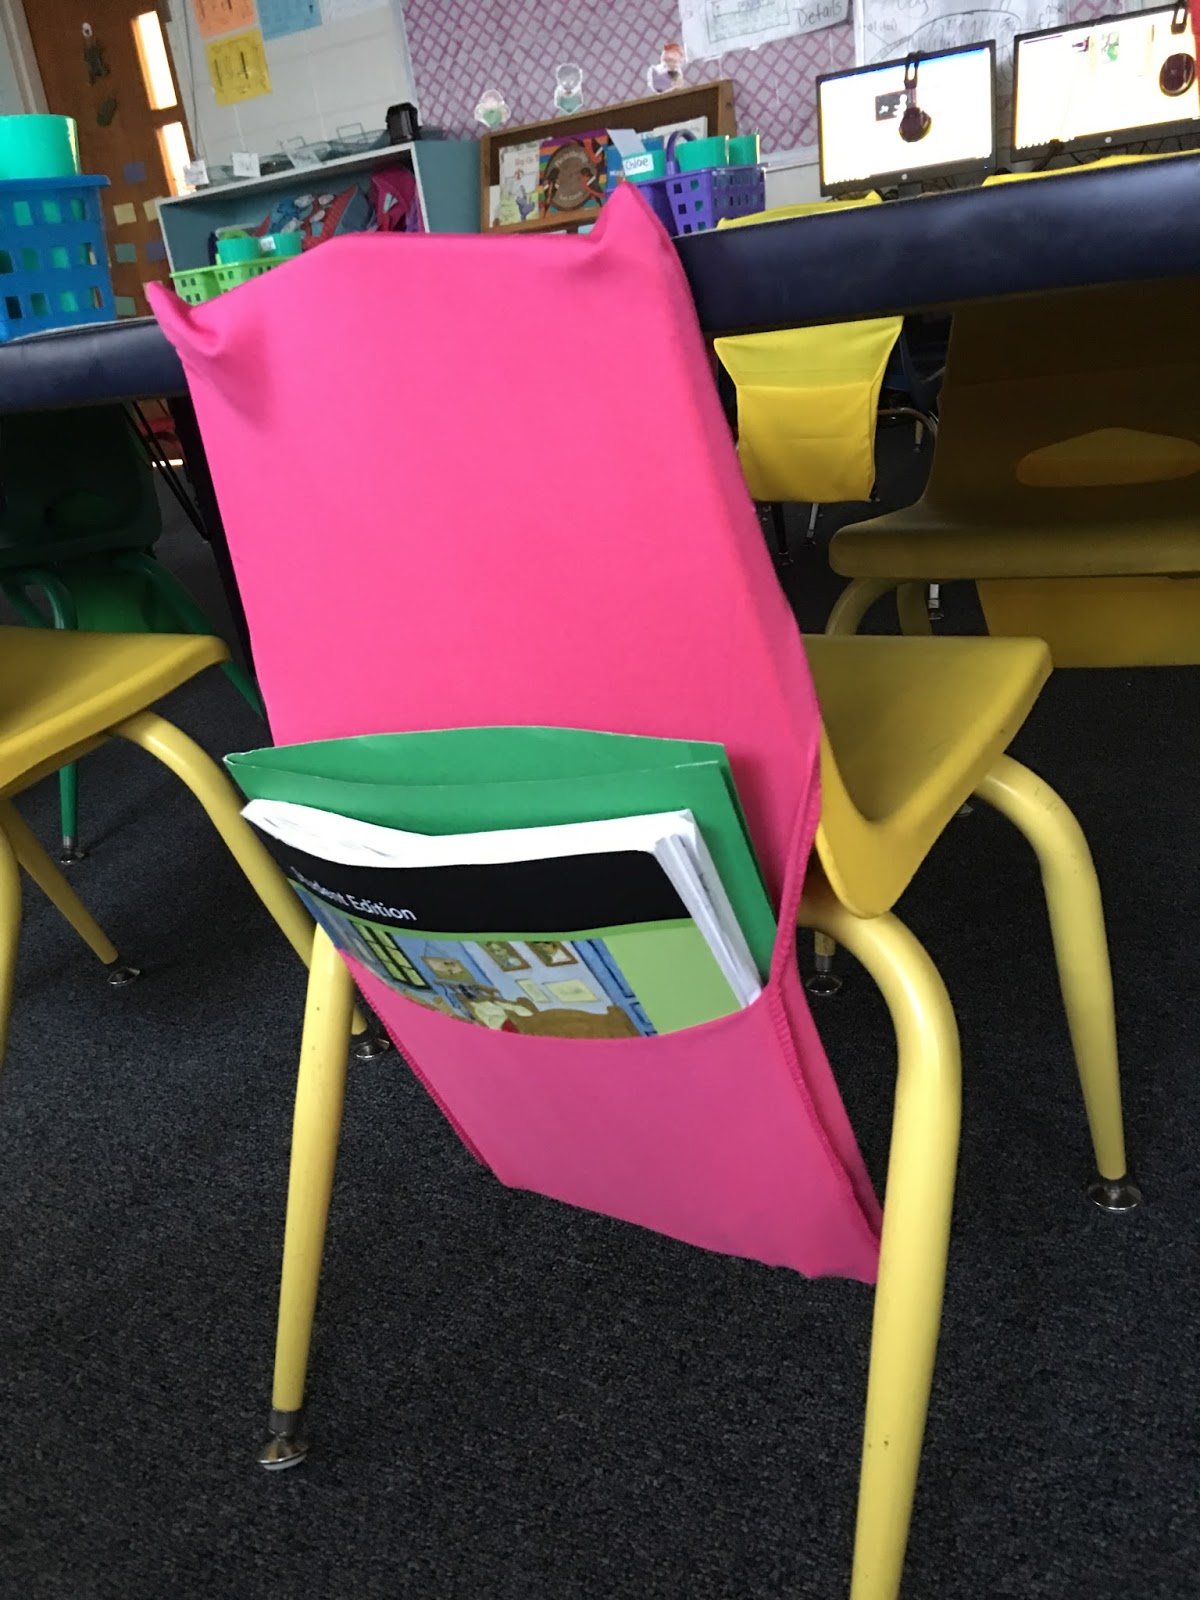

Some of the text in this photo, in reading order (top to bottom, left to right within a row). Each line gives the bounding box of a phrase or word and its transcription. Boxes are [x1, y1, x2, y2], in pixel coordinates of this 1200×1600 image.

[796, 0, 844, 27] Details
[625, 157, 649, 171] Chloe
[345, 893, 417, 921] Edition
